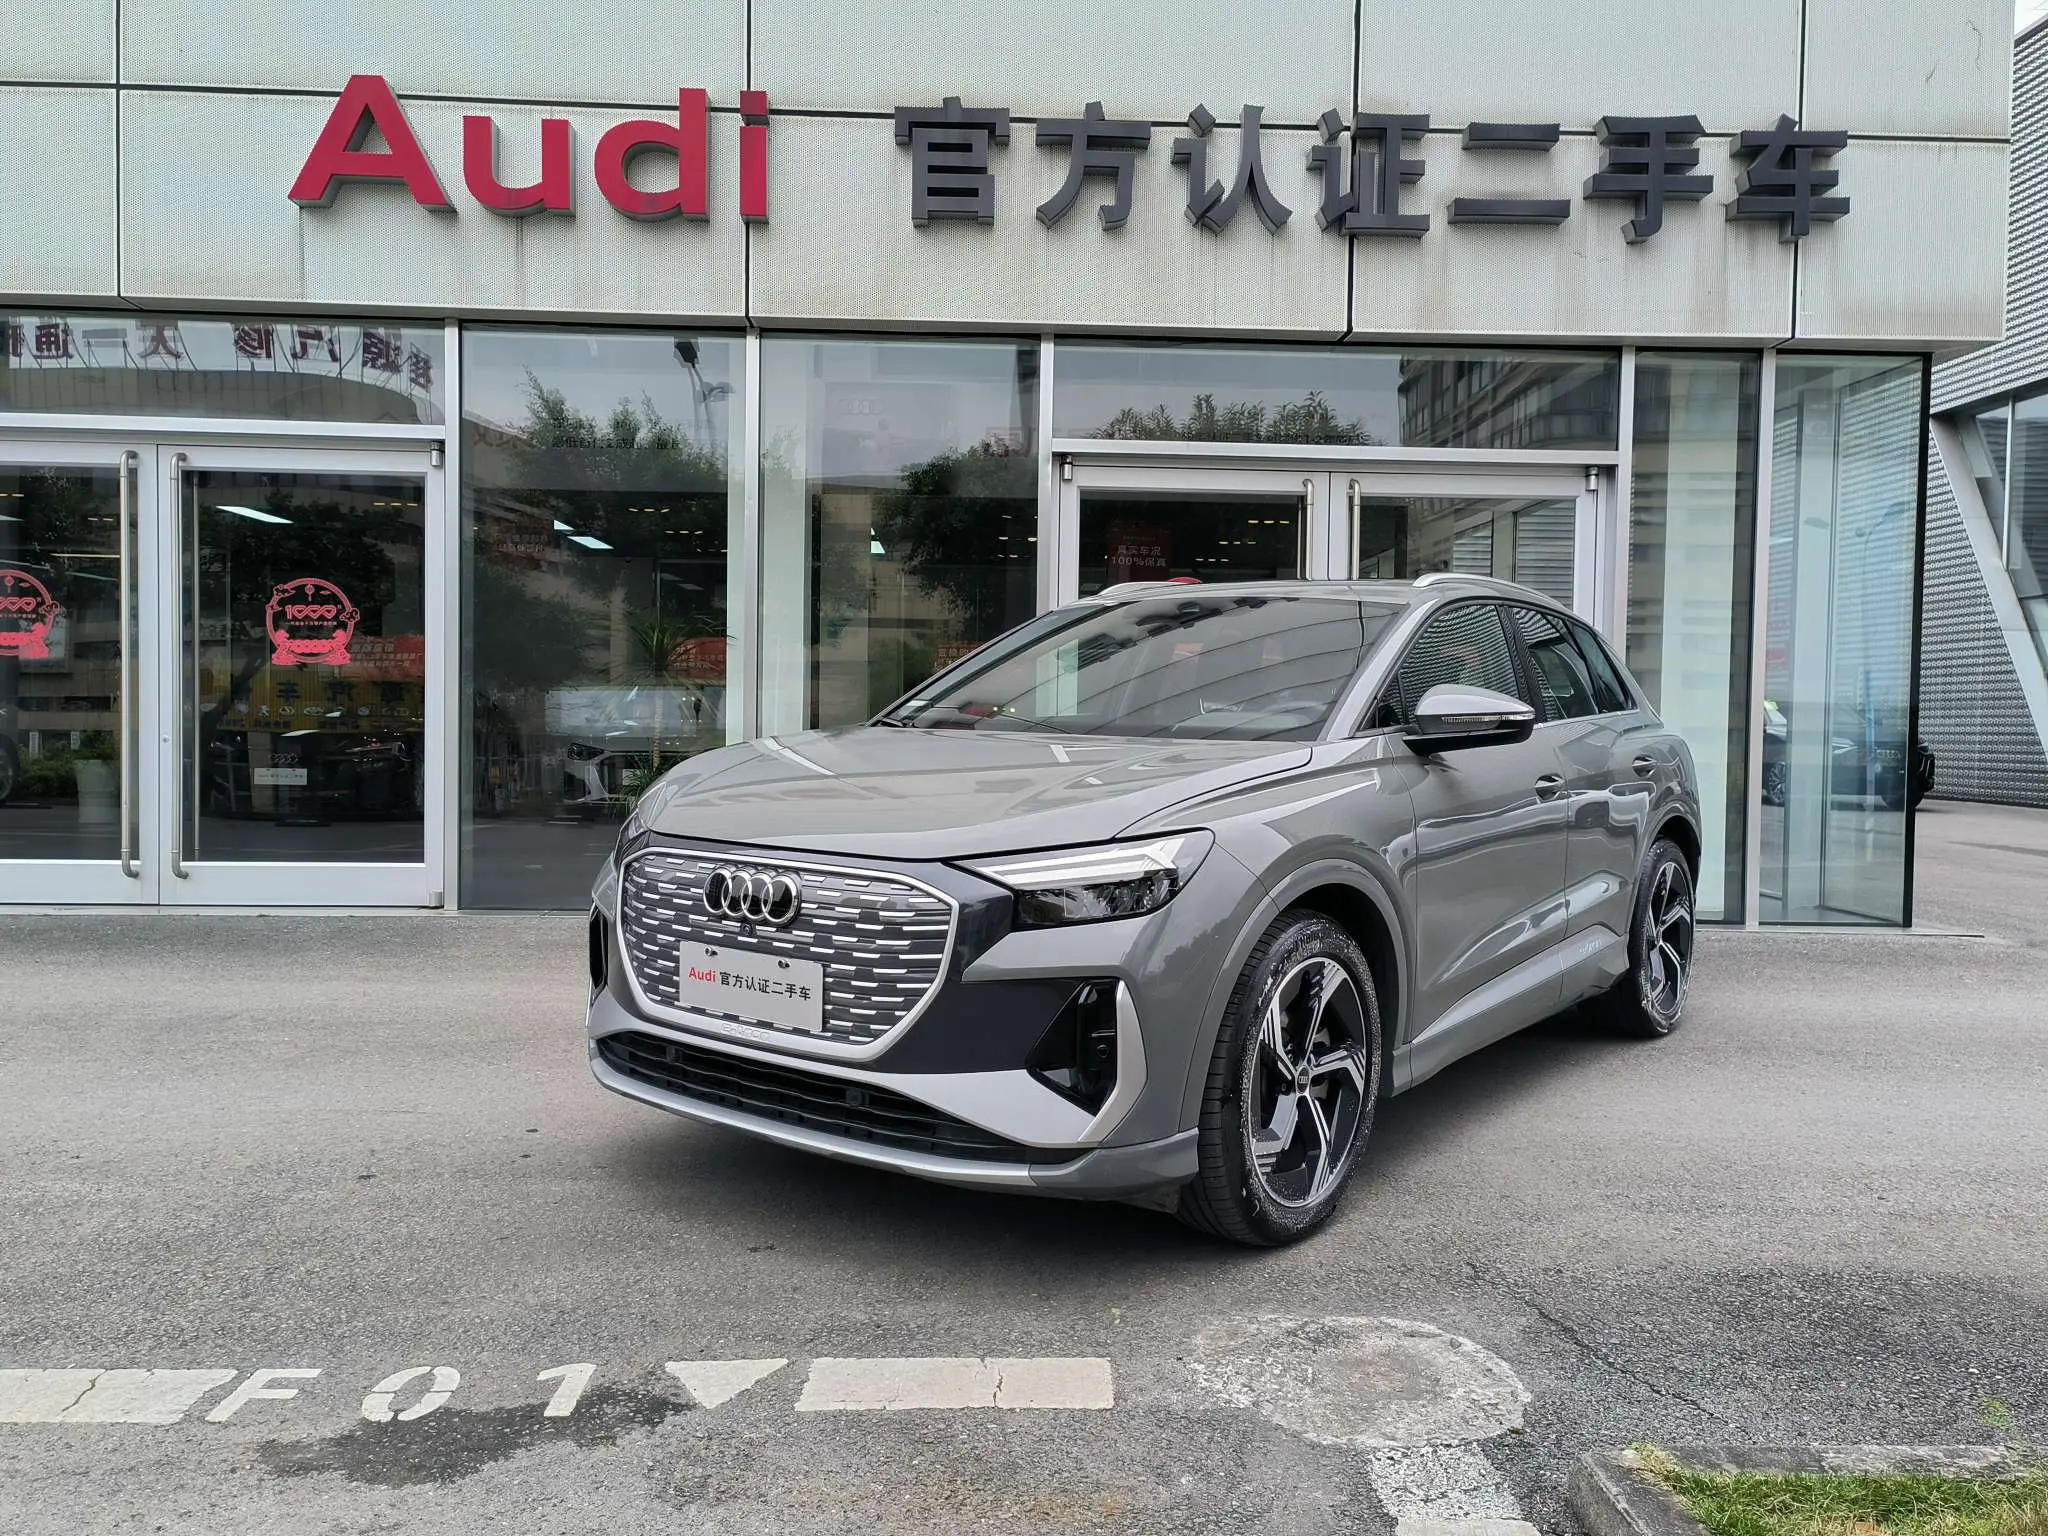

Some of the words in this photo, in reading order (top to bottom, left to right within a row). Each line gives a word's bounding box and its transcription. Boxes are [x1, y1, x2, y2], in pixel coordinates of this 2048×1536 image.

[288, 74, 769, 223] Audi
[894, 95, 1850, 244] 官方认证二手车
[688, 967, 716, 983] Audi
[719, 971, 812, 1001] 官方认证二手车
